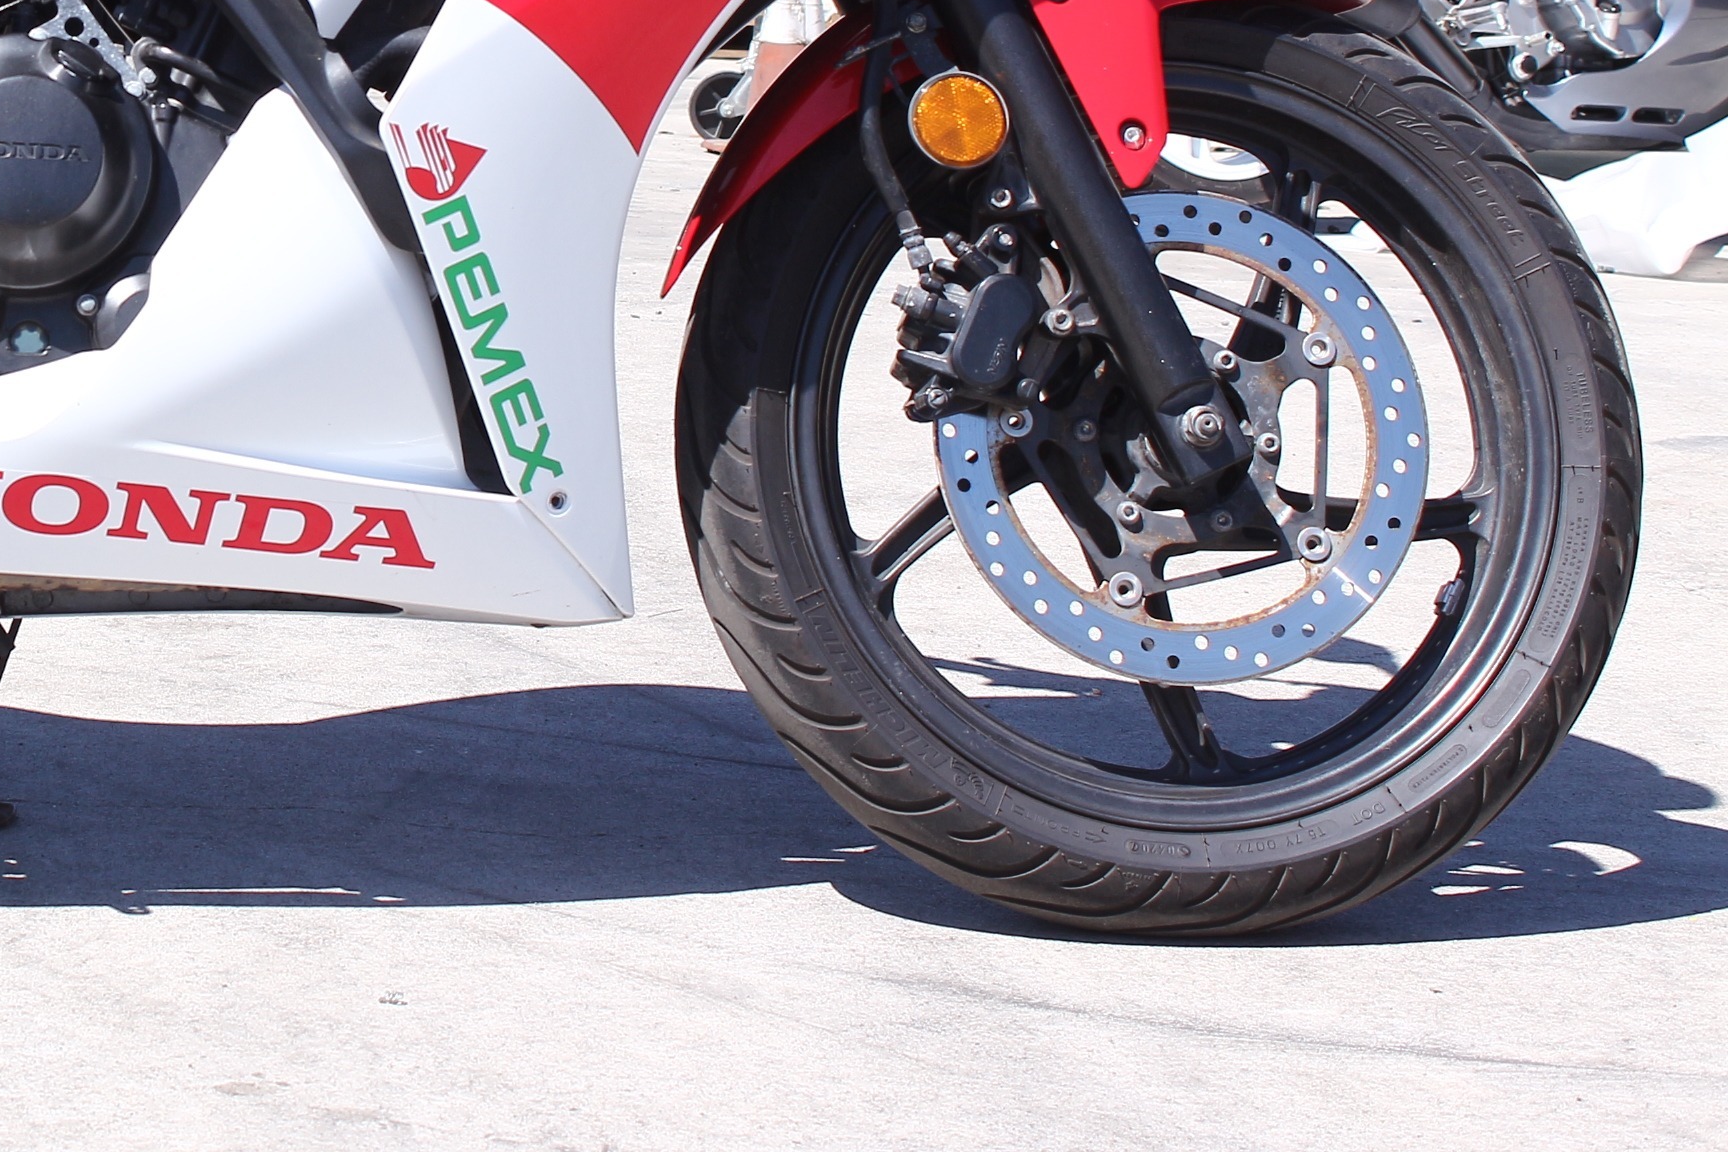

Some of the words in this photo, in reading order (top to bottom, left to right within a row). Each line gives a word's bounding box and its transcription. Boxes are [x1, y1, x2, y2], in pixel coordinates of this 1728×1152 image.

[421, 194, 563, 495] PEMEX
[1575, 370, 1593, 433] TUBELESS
[812, 614, 949, 773] MICHELIN
[1349, 799, 1386, 826] DOT
